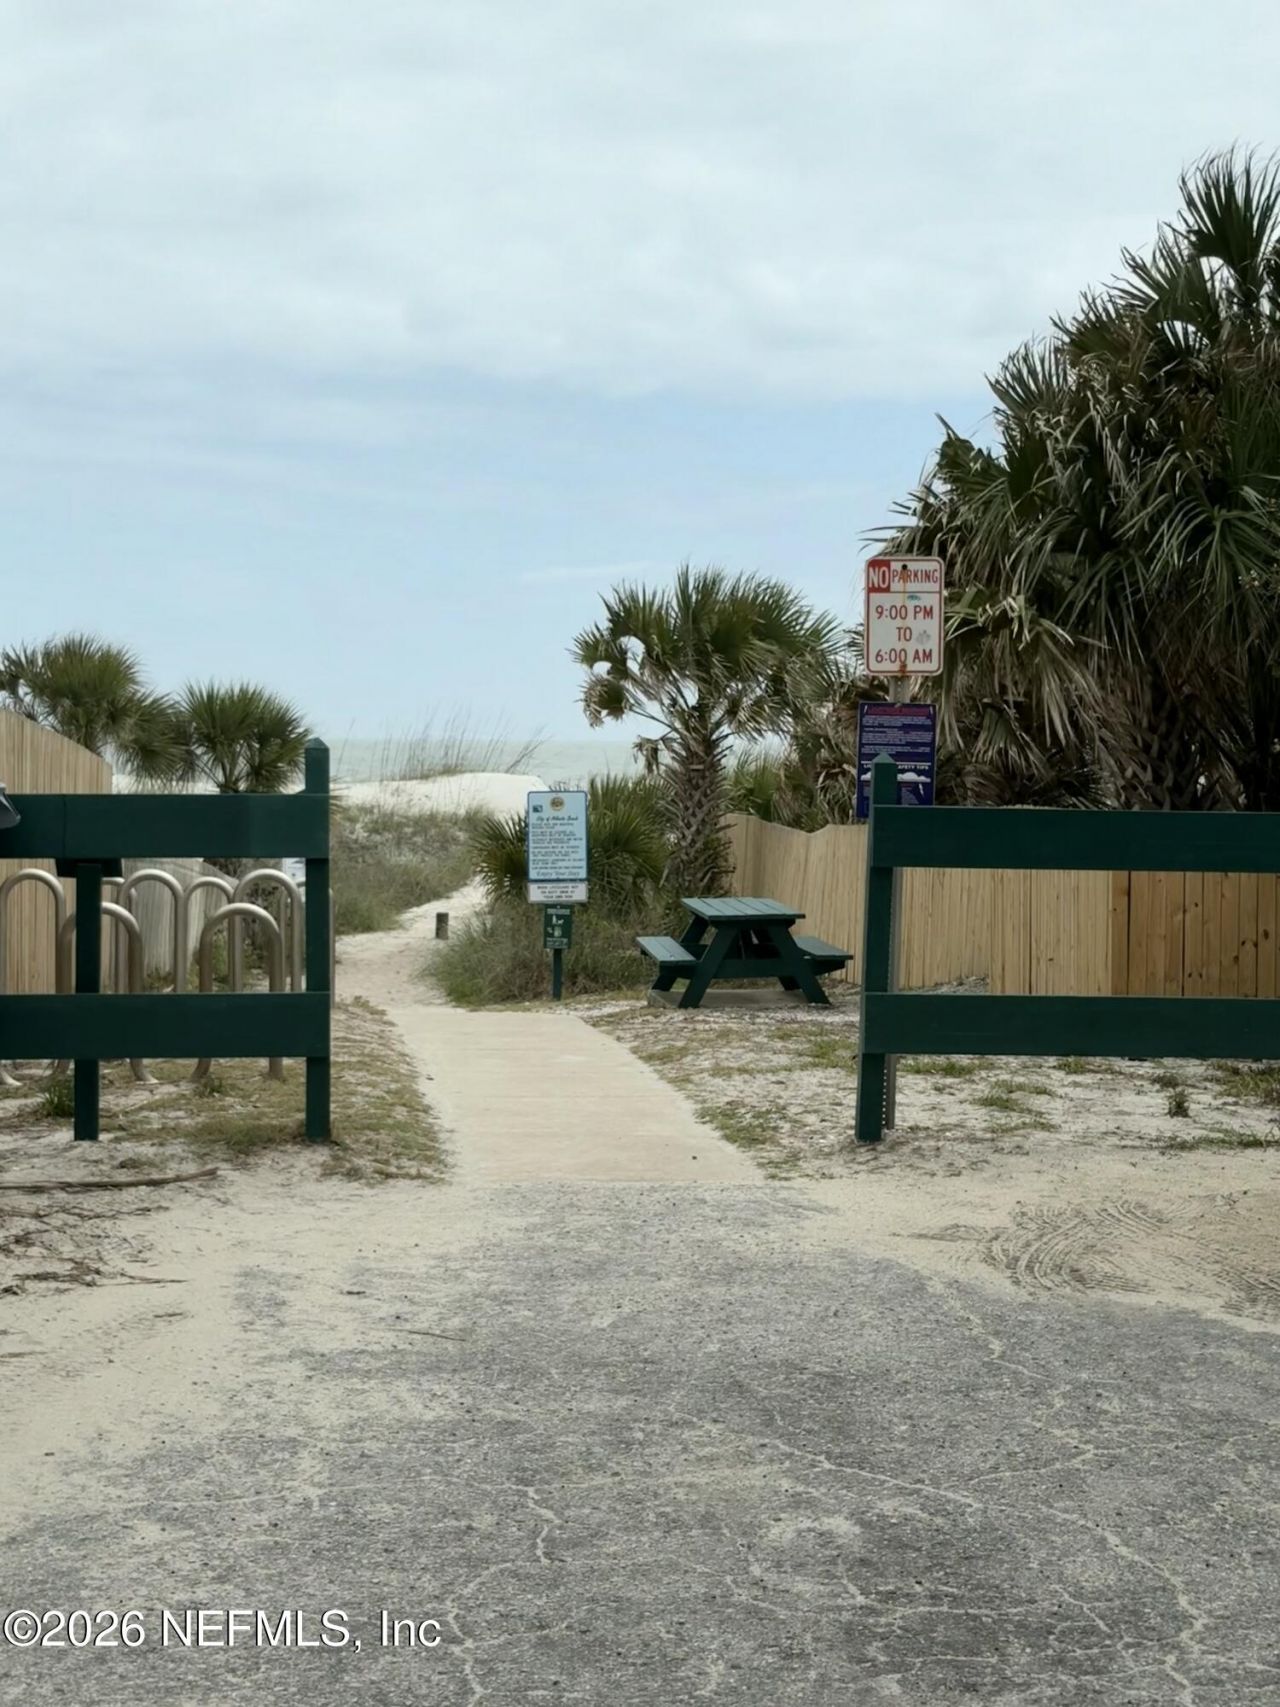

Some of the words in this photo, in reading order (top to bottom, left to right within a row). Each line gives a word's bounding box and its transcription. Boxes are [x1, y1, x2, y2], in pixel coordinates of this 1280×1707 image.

[868, 566, 889, 589] NO
[892, 569, 939, 584] PARKING
[875, 604, 908, 621] 9:00
[913, 605, 933, 620] PM
[895, 626, 912, 642] TO
[875, 648, 908, 664] 6:00
[912, 648, 933, 664] AM
